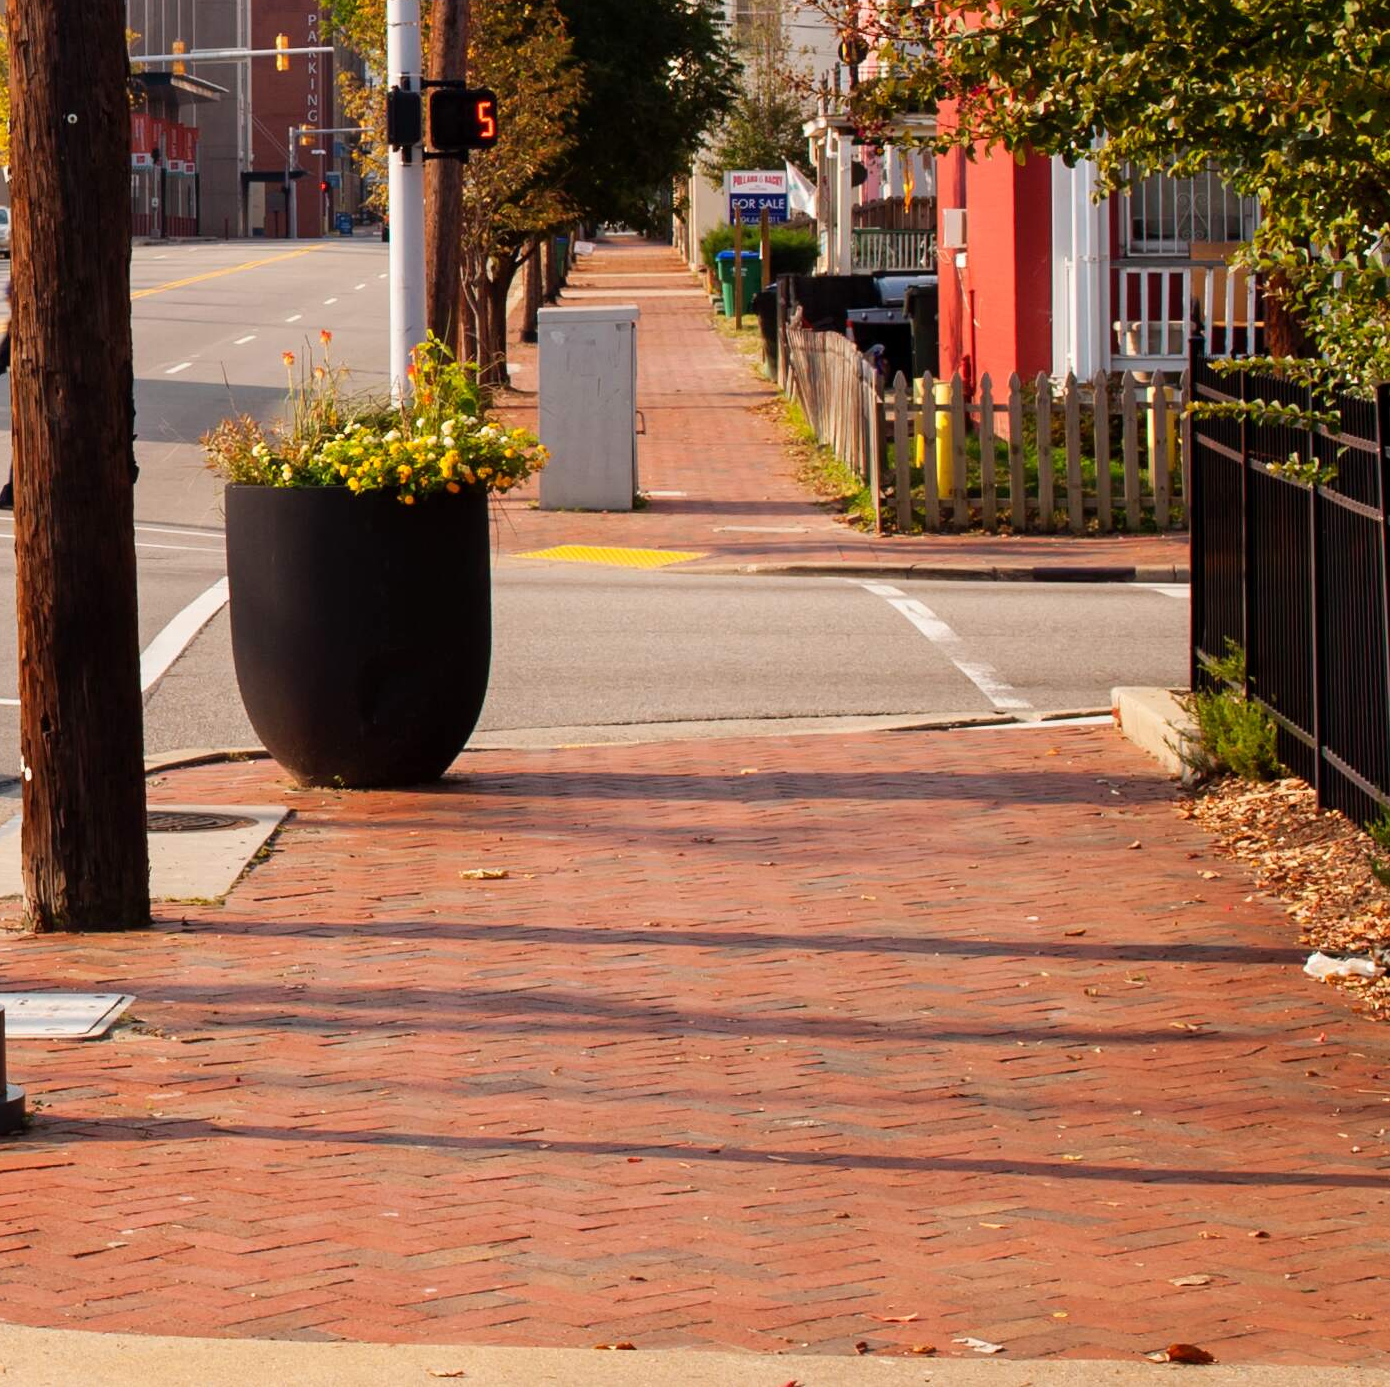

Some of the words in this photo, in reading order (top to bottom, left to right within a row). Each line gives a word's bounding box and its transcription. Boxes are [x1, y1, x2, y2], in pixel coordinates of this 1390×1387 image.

[478, 101, 495, 138] 5
[732, 198, 757, 210] FOR
[758, 198, 785, 209] SALE
